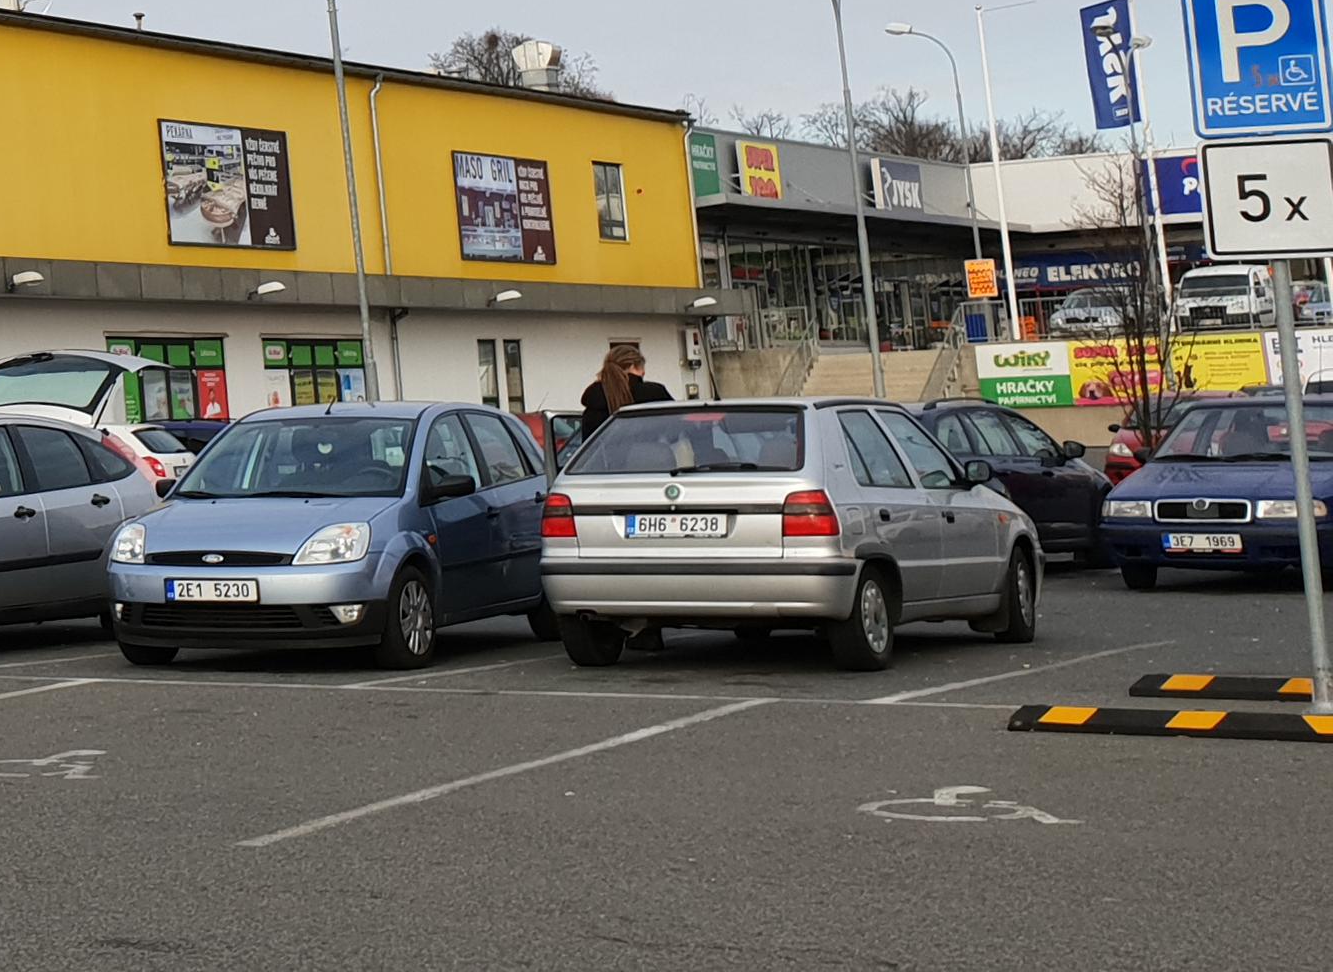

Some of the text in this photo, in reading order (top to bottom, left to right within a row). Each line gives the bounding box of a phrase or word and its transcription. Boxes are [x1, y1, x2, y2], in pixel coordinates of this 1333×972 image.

[1206, 86, 1320, 117] RÉSERVÉ
[455, 154, 513, 183] MASO GRIL
[893, 180, 921, 208] JYSK
[1237, 174, 1271, 223] 5
[995, 267, 1039, 278] PLNEO
[996, 378, 1055, 394] HRAČKY
[639, 517, 718, 532] 6H6 6238
[1173, 535, 1235, 547] 3E7 1969
[177, 583, 250, 598] 2E1 5230
